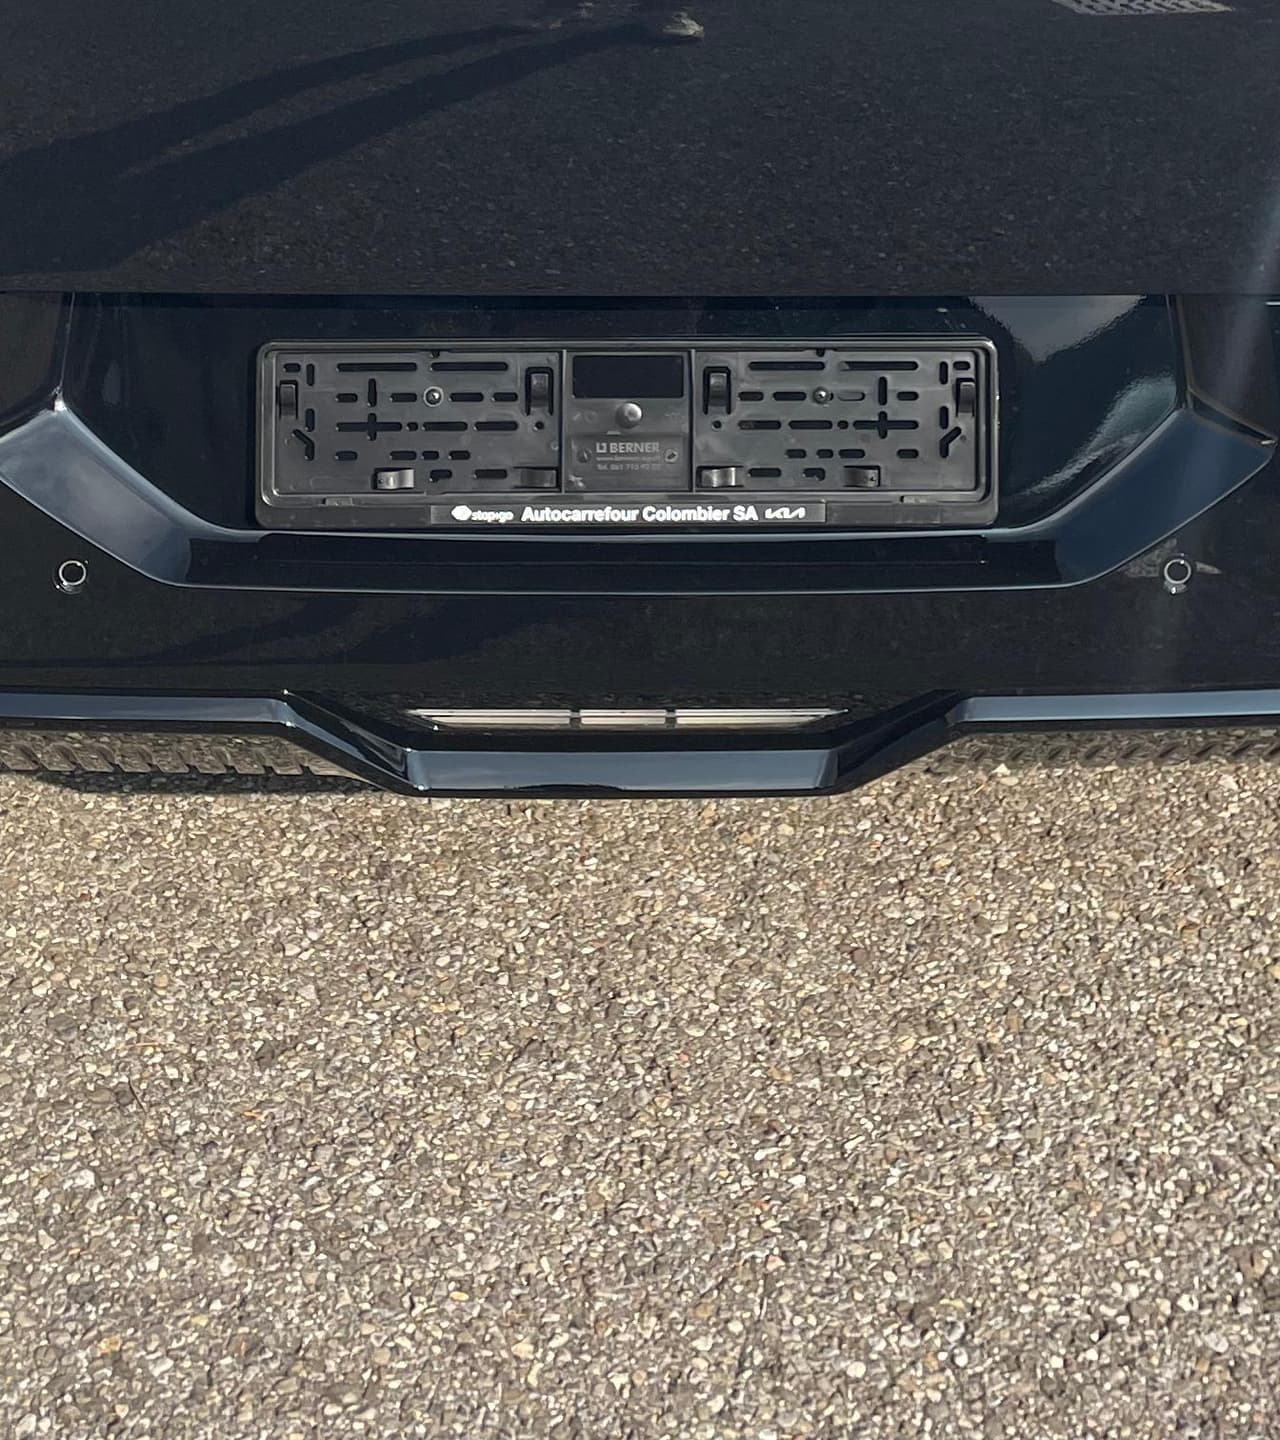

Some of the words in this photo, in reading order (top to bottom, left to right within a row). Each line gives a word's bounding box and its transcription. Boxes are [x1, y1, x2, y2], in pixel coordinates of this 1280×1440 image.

[609, 442, 660, 453] BERNER
[521, 506, 639, 522] Autocarrefour
[642, 505, 730, 522] Colombier
[733, 505, 759, 521] SA
[765, 507, 806, 519] KIA
